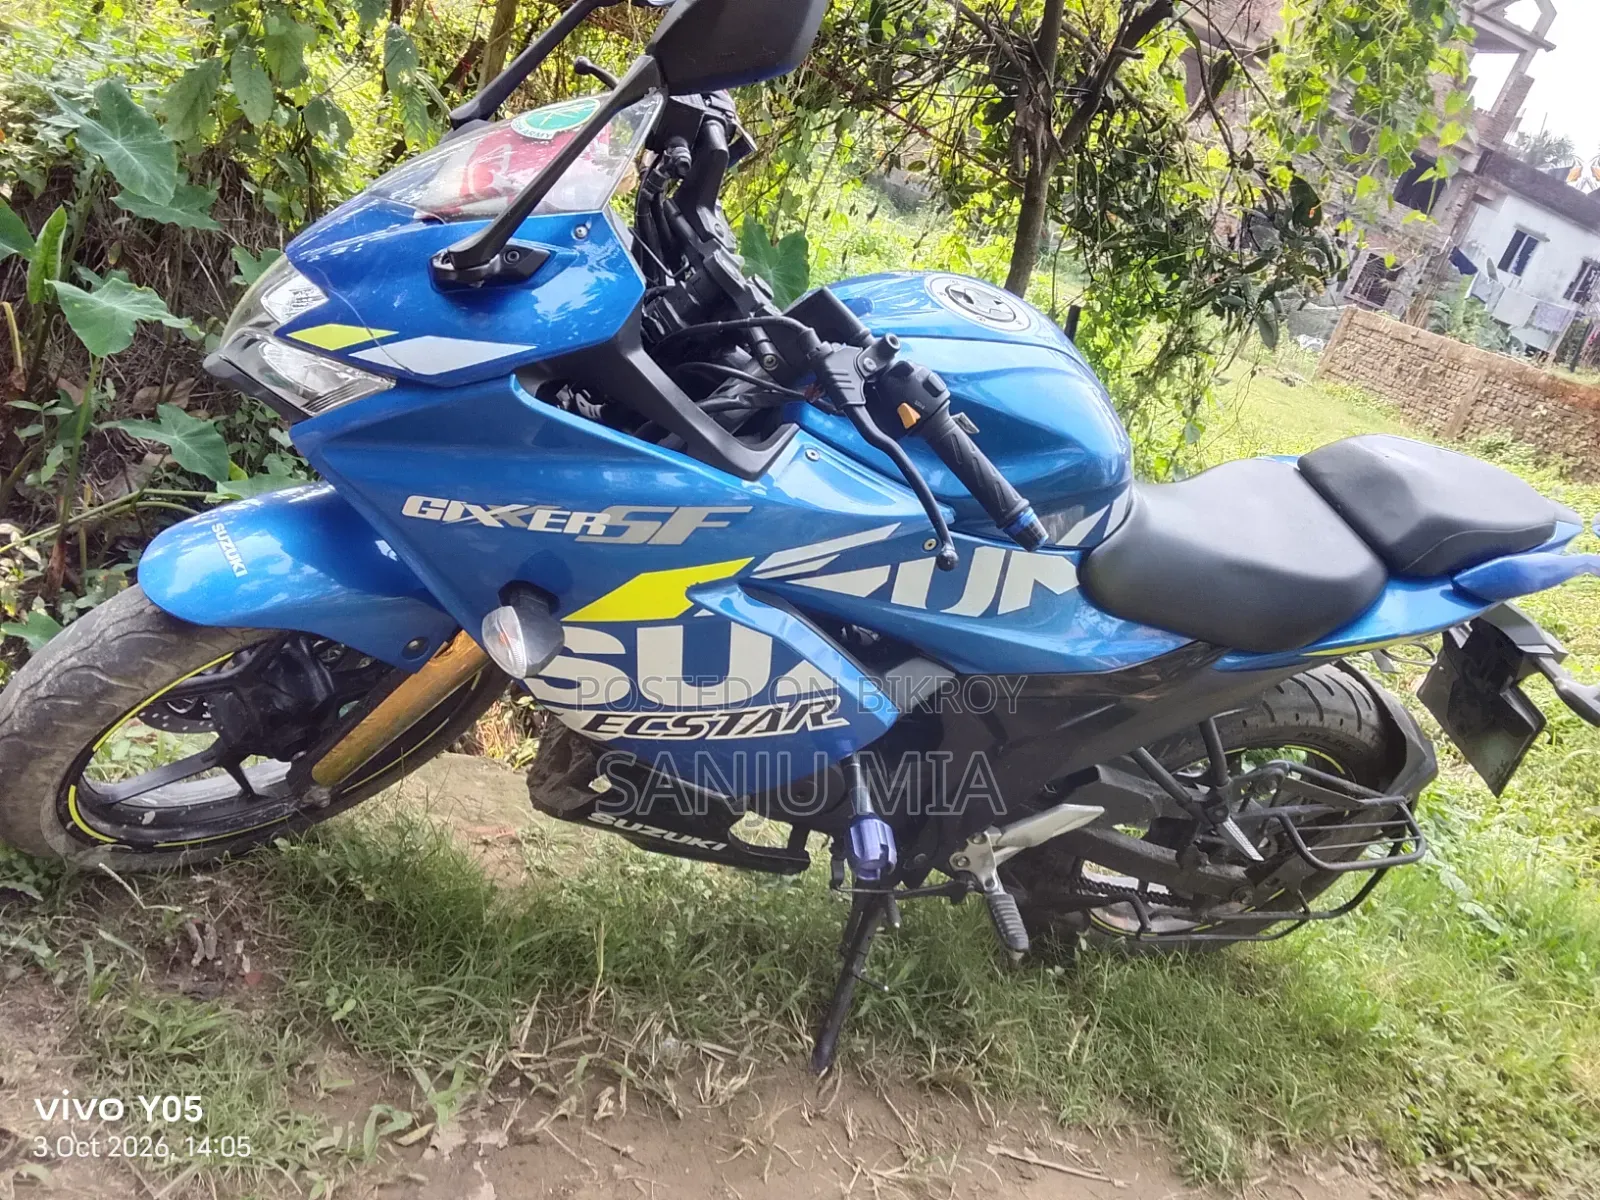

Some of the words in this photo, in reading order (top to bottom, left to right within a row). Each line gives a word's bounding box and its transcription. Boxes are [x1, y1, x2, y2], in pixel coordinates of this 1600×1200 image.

[401, 495, 612, 535] GIXXER
[575, 505, 753, 545] SF
[211, 523, 249, 577] SUZUKI
[580, 695, 850, 741] ECSTAR
[587, 812, 728, 851] SUZUKI
